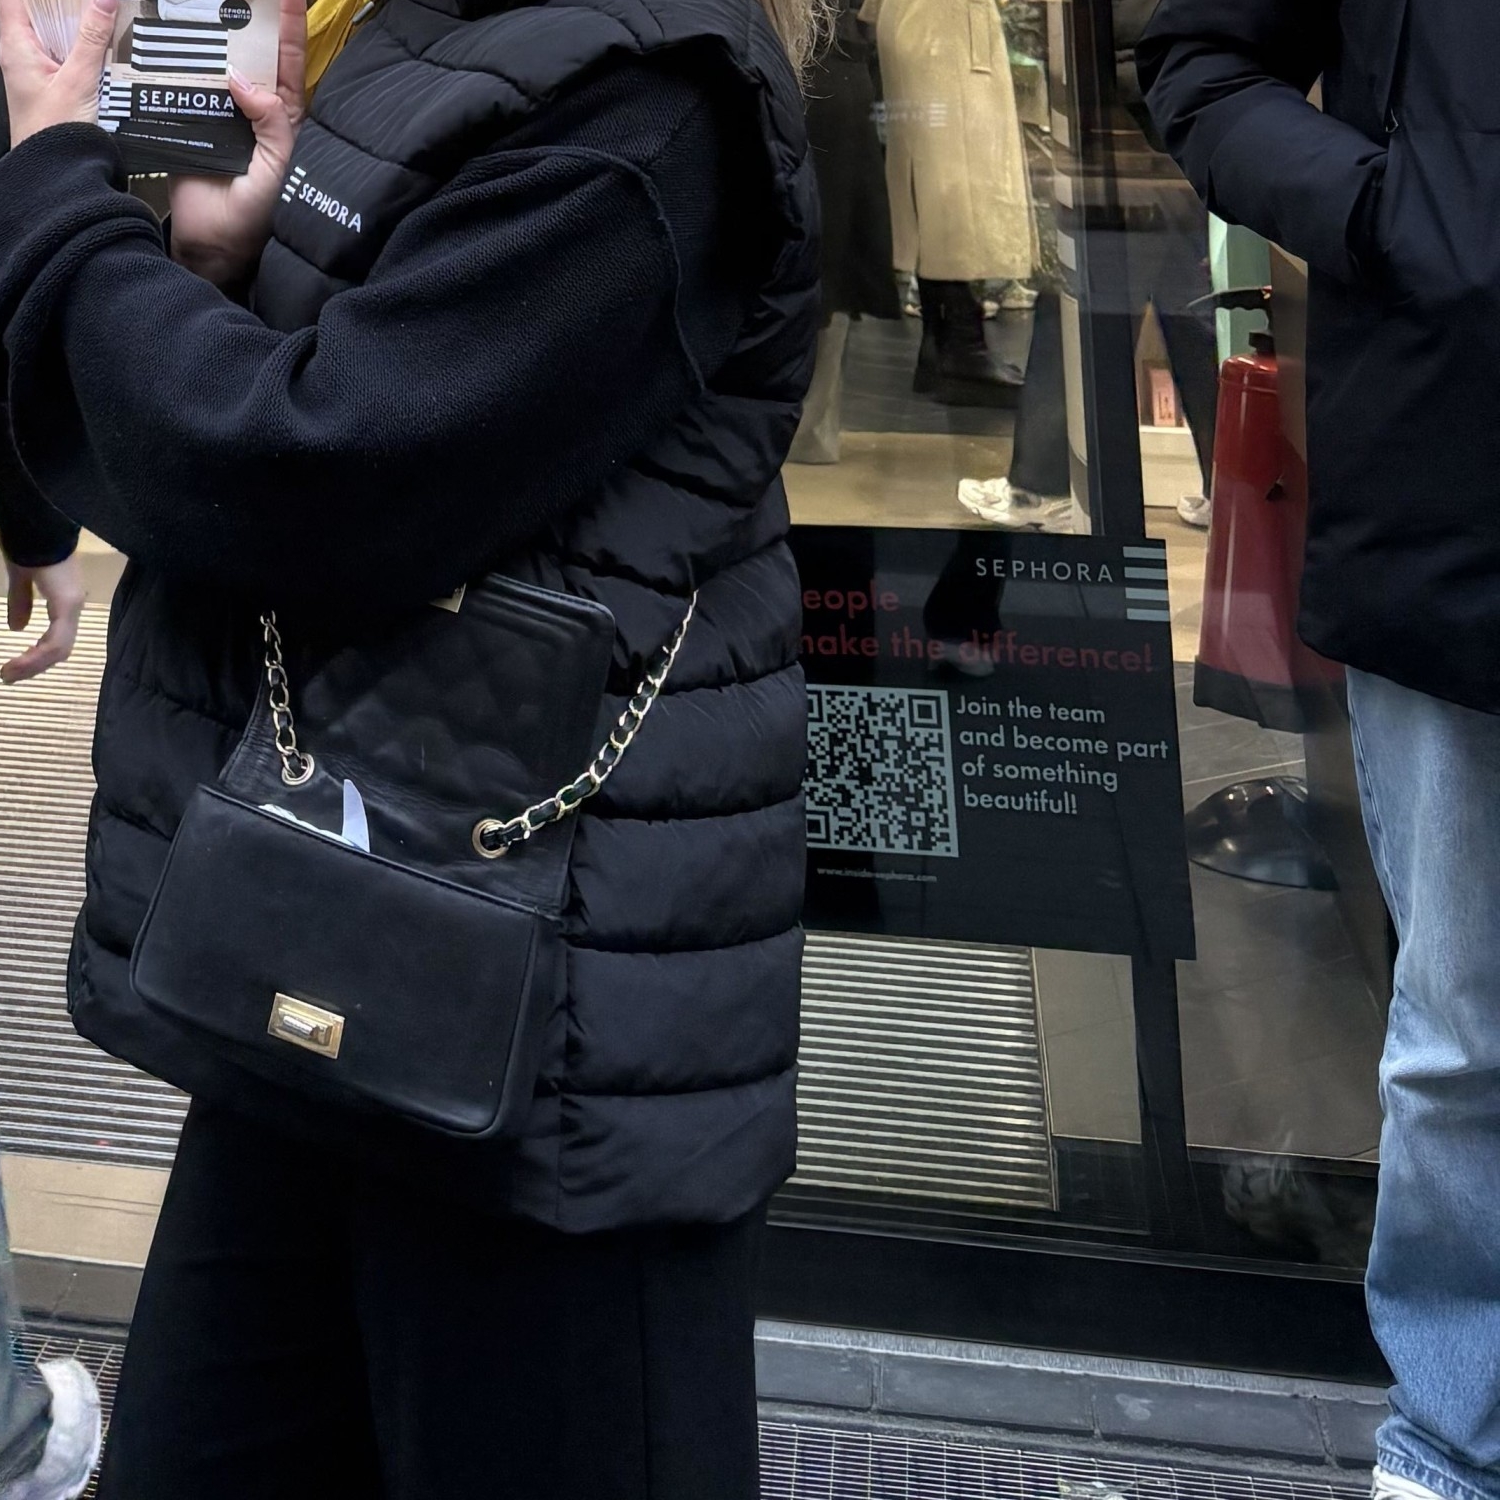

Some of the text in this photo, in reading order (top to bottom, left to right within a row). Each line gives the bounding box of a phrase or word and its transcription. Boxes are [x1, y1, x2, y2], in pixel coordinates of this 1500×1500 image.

[139, 89, 234, 110] SEPHORA
[298, 183, 361, 233] SEPHORA
[975, 557, 1114, 583] SEPHORA
[803, 579, 899, 618] eople
[891, 625, 947, 660] the
[958, 629, 1153, 673] difference!
[956, 694, 1105, 724] Join the team
[960, 726, 1169, 762] and become part
[961, 754, 1119, 793] of something
[963, 784, 1078, 816] beautiful!
